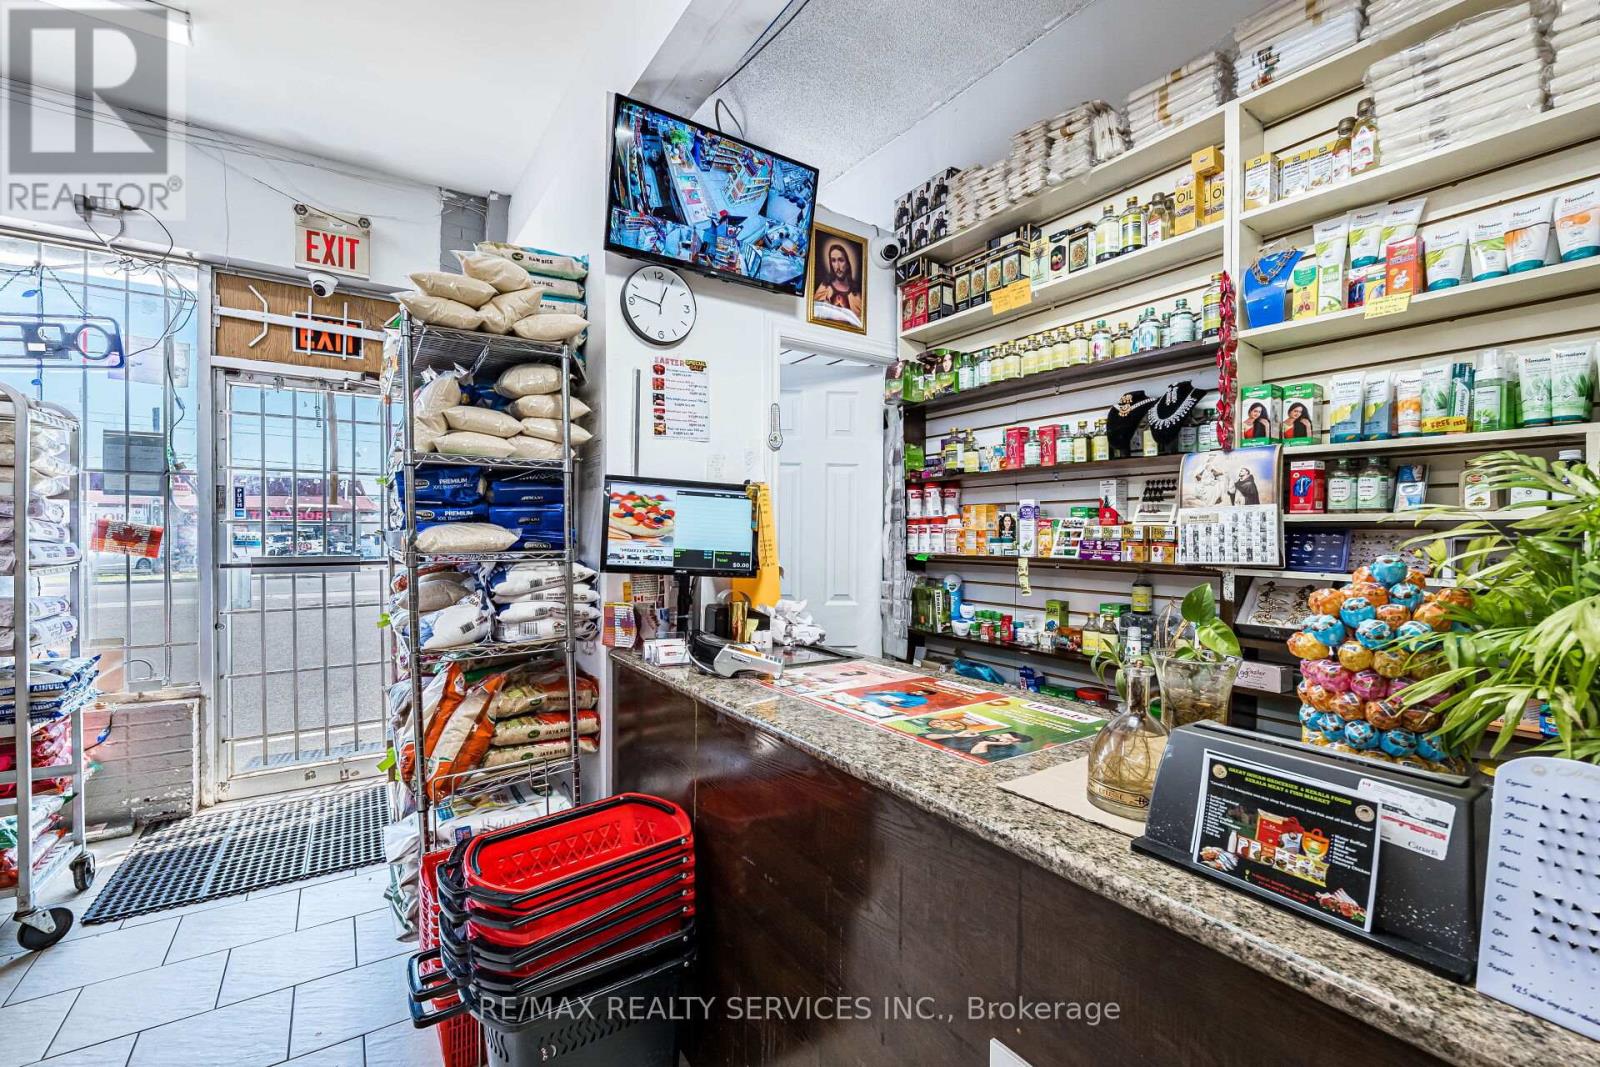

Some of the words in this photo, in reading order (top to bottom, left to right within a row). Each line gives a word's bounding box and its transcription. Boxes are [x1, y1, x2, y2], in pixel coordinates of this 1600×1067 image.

[1176, 189, 1193, 204] OIL
[306, 229, 360, 270] EXIT
[654, 271, 664, 281] 12
[628, 296, 636, 306] 9
[683, 304, 691, 314] 3
[299, 317, 358, 354] EXIT
[657, 330, 665, 340] 6
[1430, 418, 1450, 430] FREE
[1452, 418, 1467, 427] FREE
[236, 488, 244, 508] PUSH
[1122, 525, 1142, 538] Bigen
[1151, 525, 1174, 538] Bigen
